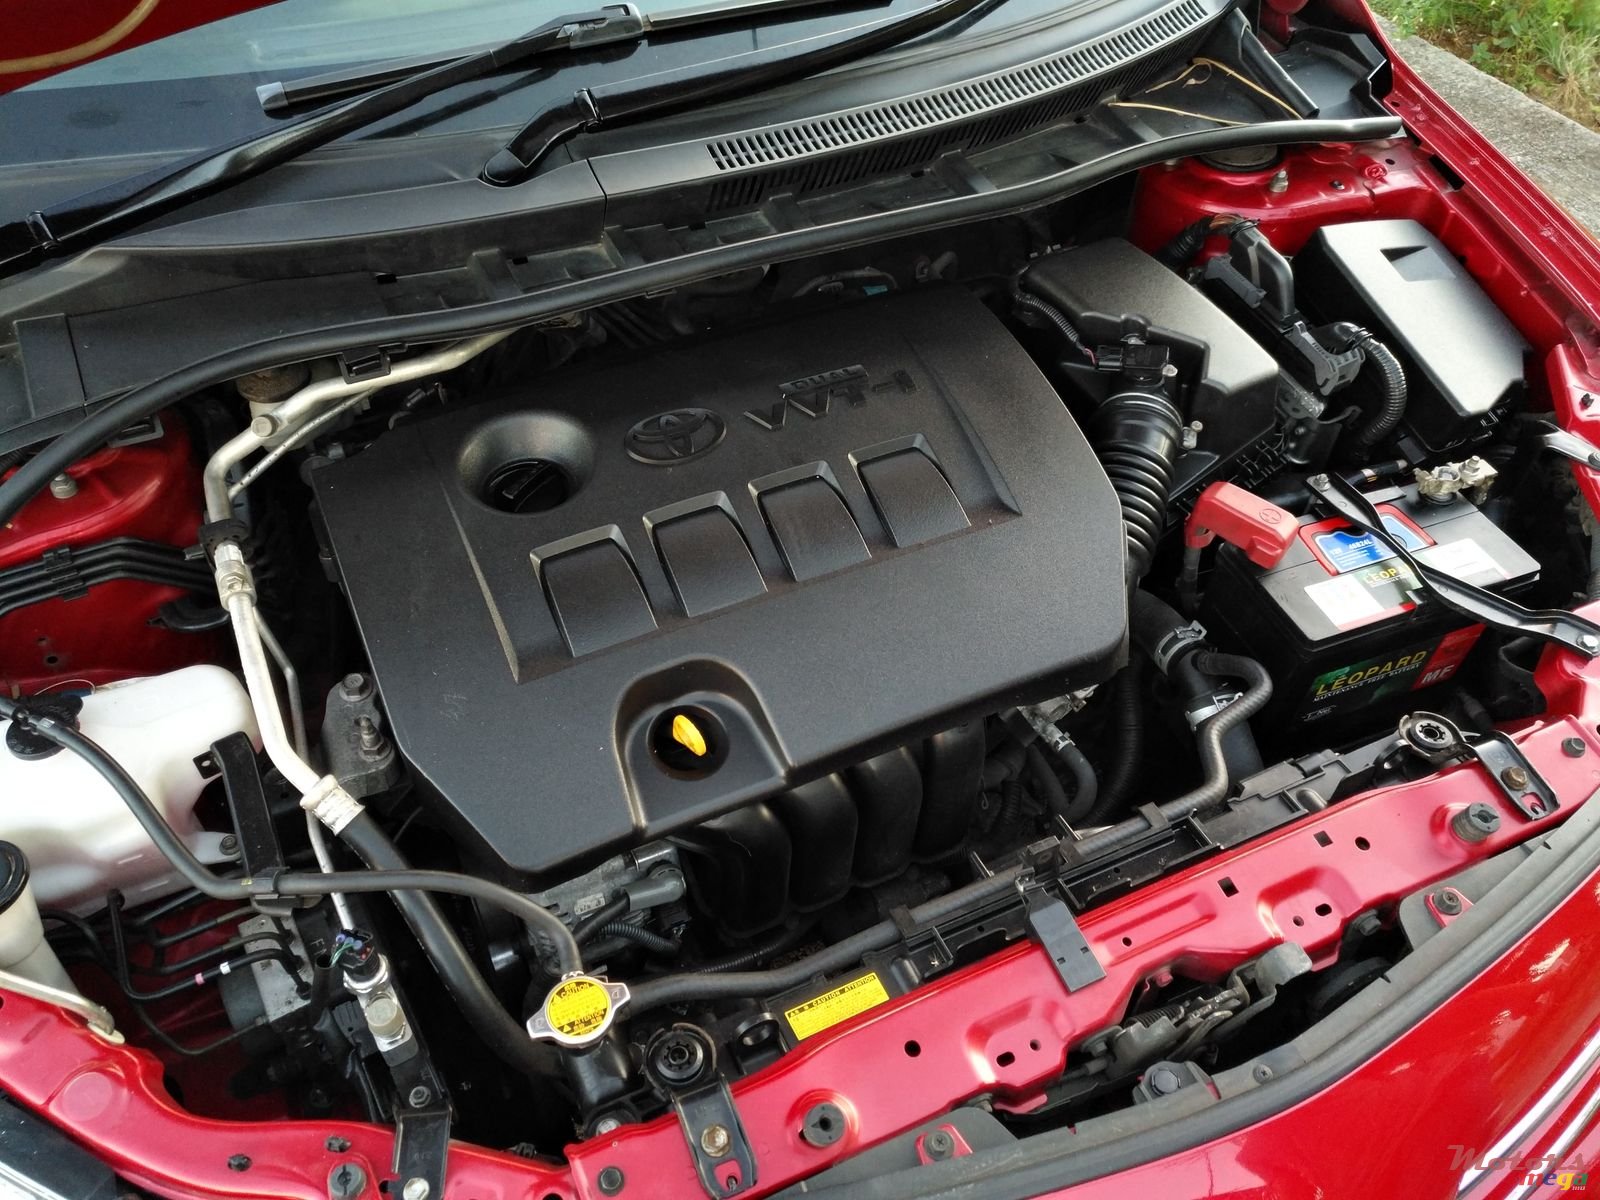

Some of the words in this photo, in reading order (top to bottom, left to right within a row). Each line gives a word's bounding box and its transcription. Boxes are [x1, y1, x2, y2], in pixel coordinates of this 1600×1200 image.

[789, 367, 859, 391] DUAL
[1316, 650, 1428, 695] LEOPARD
[1420, 664, 1455, 685] MF
[560, 983, 590, 999] CAUTION
[811, 991, 841, 1007] CAUTION
[843, 974, 876, 993] ATTENTION
[573, 1009, 605, 1026] ATTENTION
